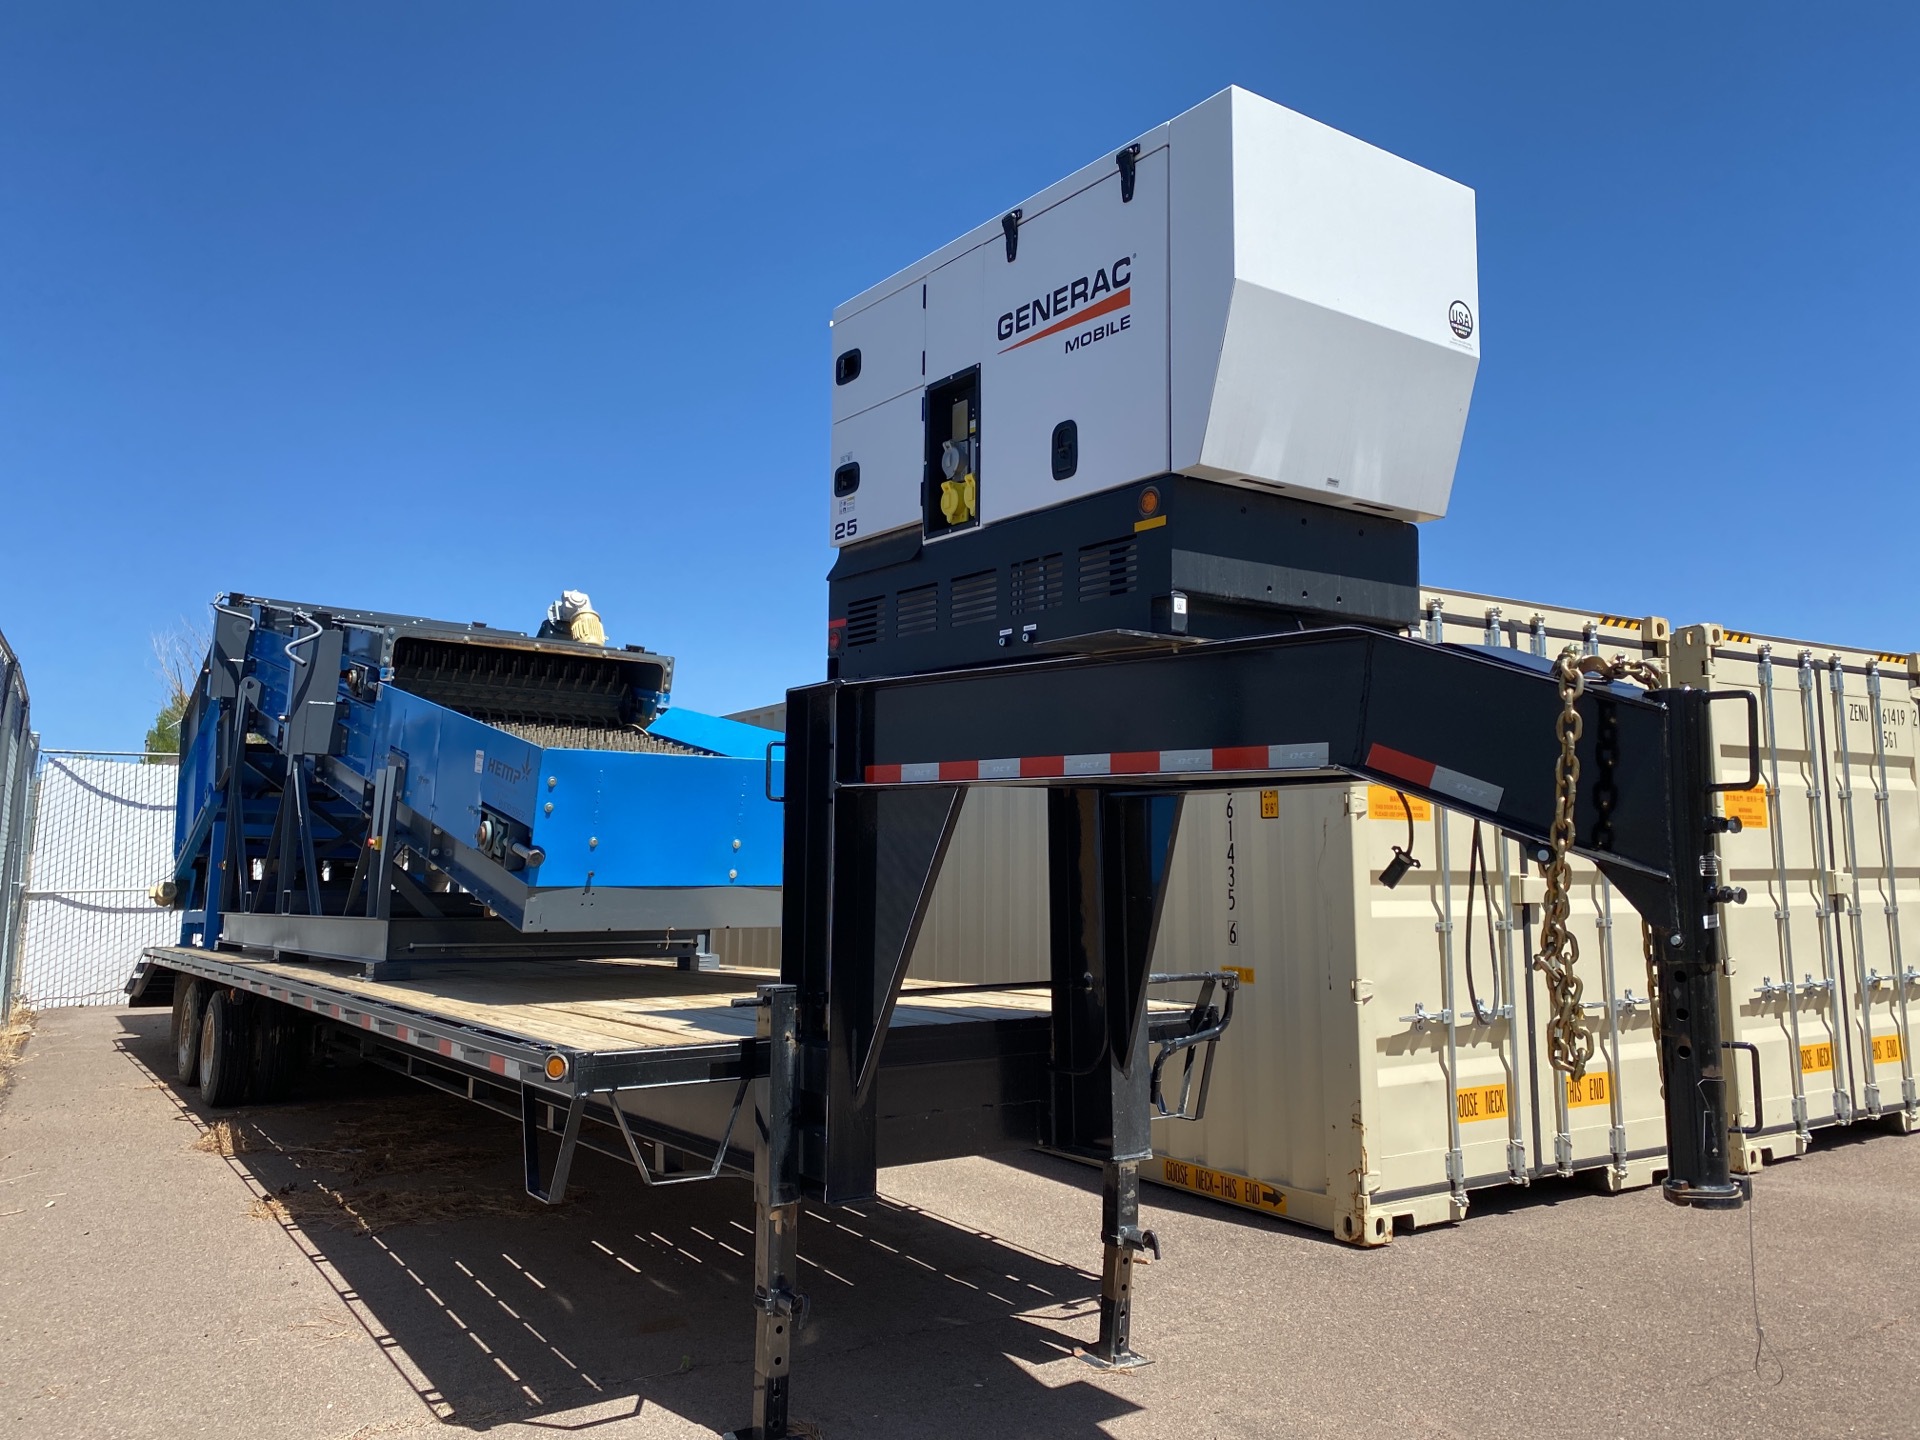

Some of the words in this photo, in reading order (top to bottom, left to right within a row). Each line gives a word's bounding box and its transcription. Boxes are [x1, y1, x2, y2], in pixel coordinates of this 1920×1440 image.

[998, 256, 1131, 341] GENERAC
[1452, 309, 1469, 327] USA
[1065, 314, 1131, 354] MOBILE
[835, 518, 857, 540] 25
[1849, 704, 1869, 722] ZENU
[1882, 708, 1905, 726] 61419
[1912, 710, 1918, 727] 2
[1884, 731, 1897, 749] 5G1
[488, 757, 521, 785] HEMP
[1226, 792, 1236, 911] 61435
[1229, 922, 1236, 944] 6
[1817, 1047, 1830, 1067] NECK
[1872, 1041, 1881, 1060] HIS
[1887, 1040, 1898, 1059] END
[1590, 1077, 1604, 1100] END
[1456, 1093, 1478, 1118] OOSE
[1485, 1089, 1505, 1114] NECK
[1166, 1161, 1188, 1186] GOOSE
[1245, 1182, 1260, 1205] END
